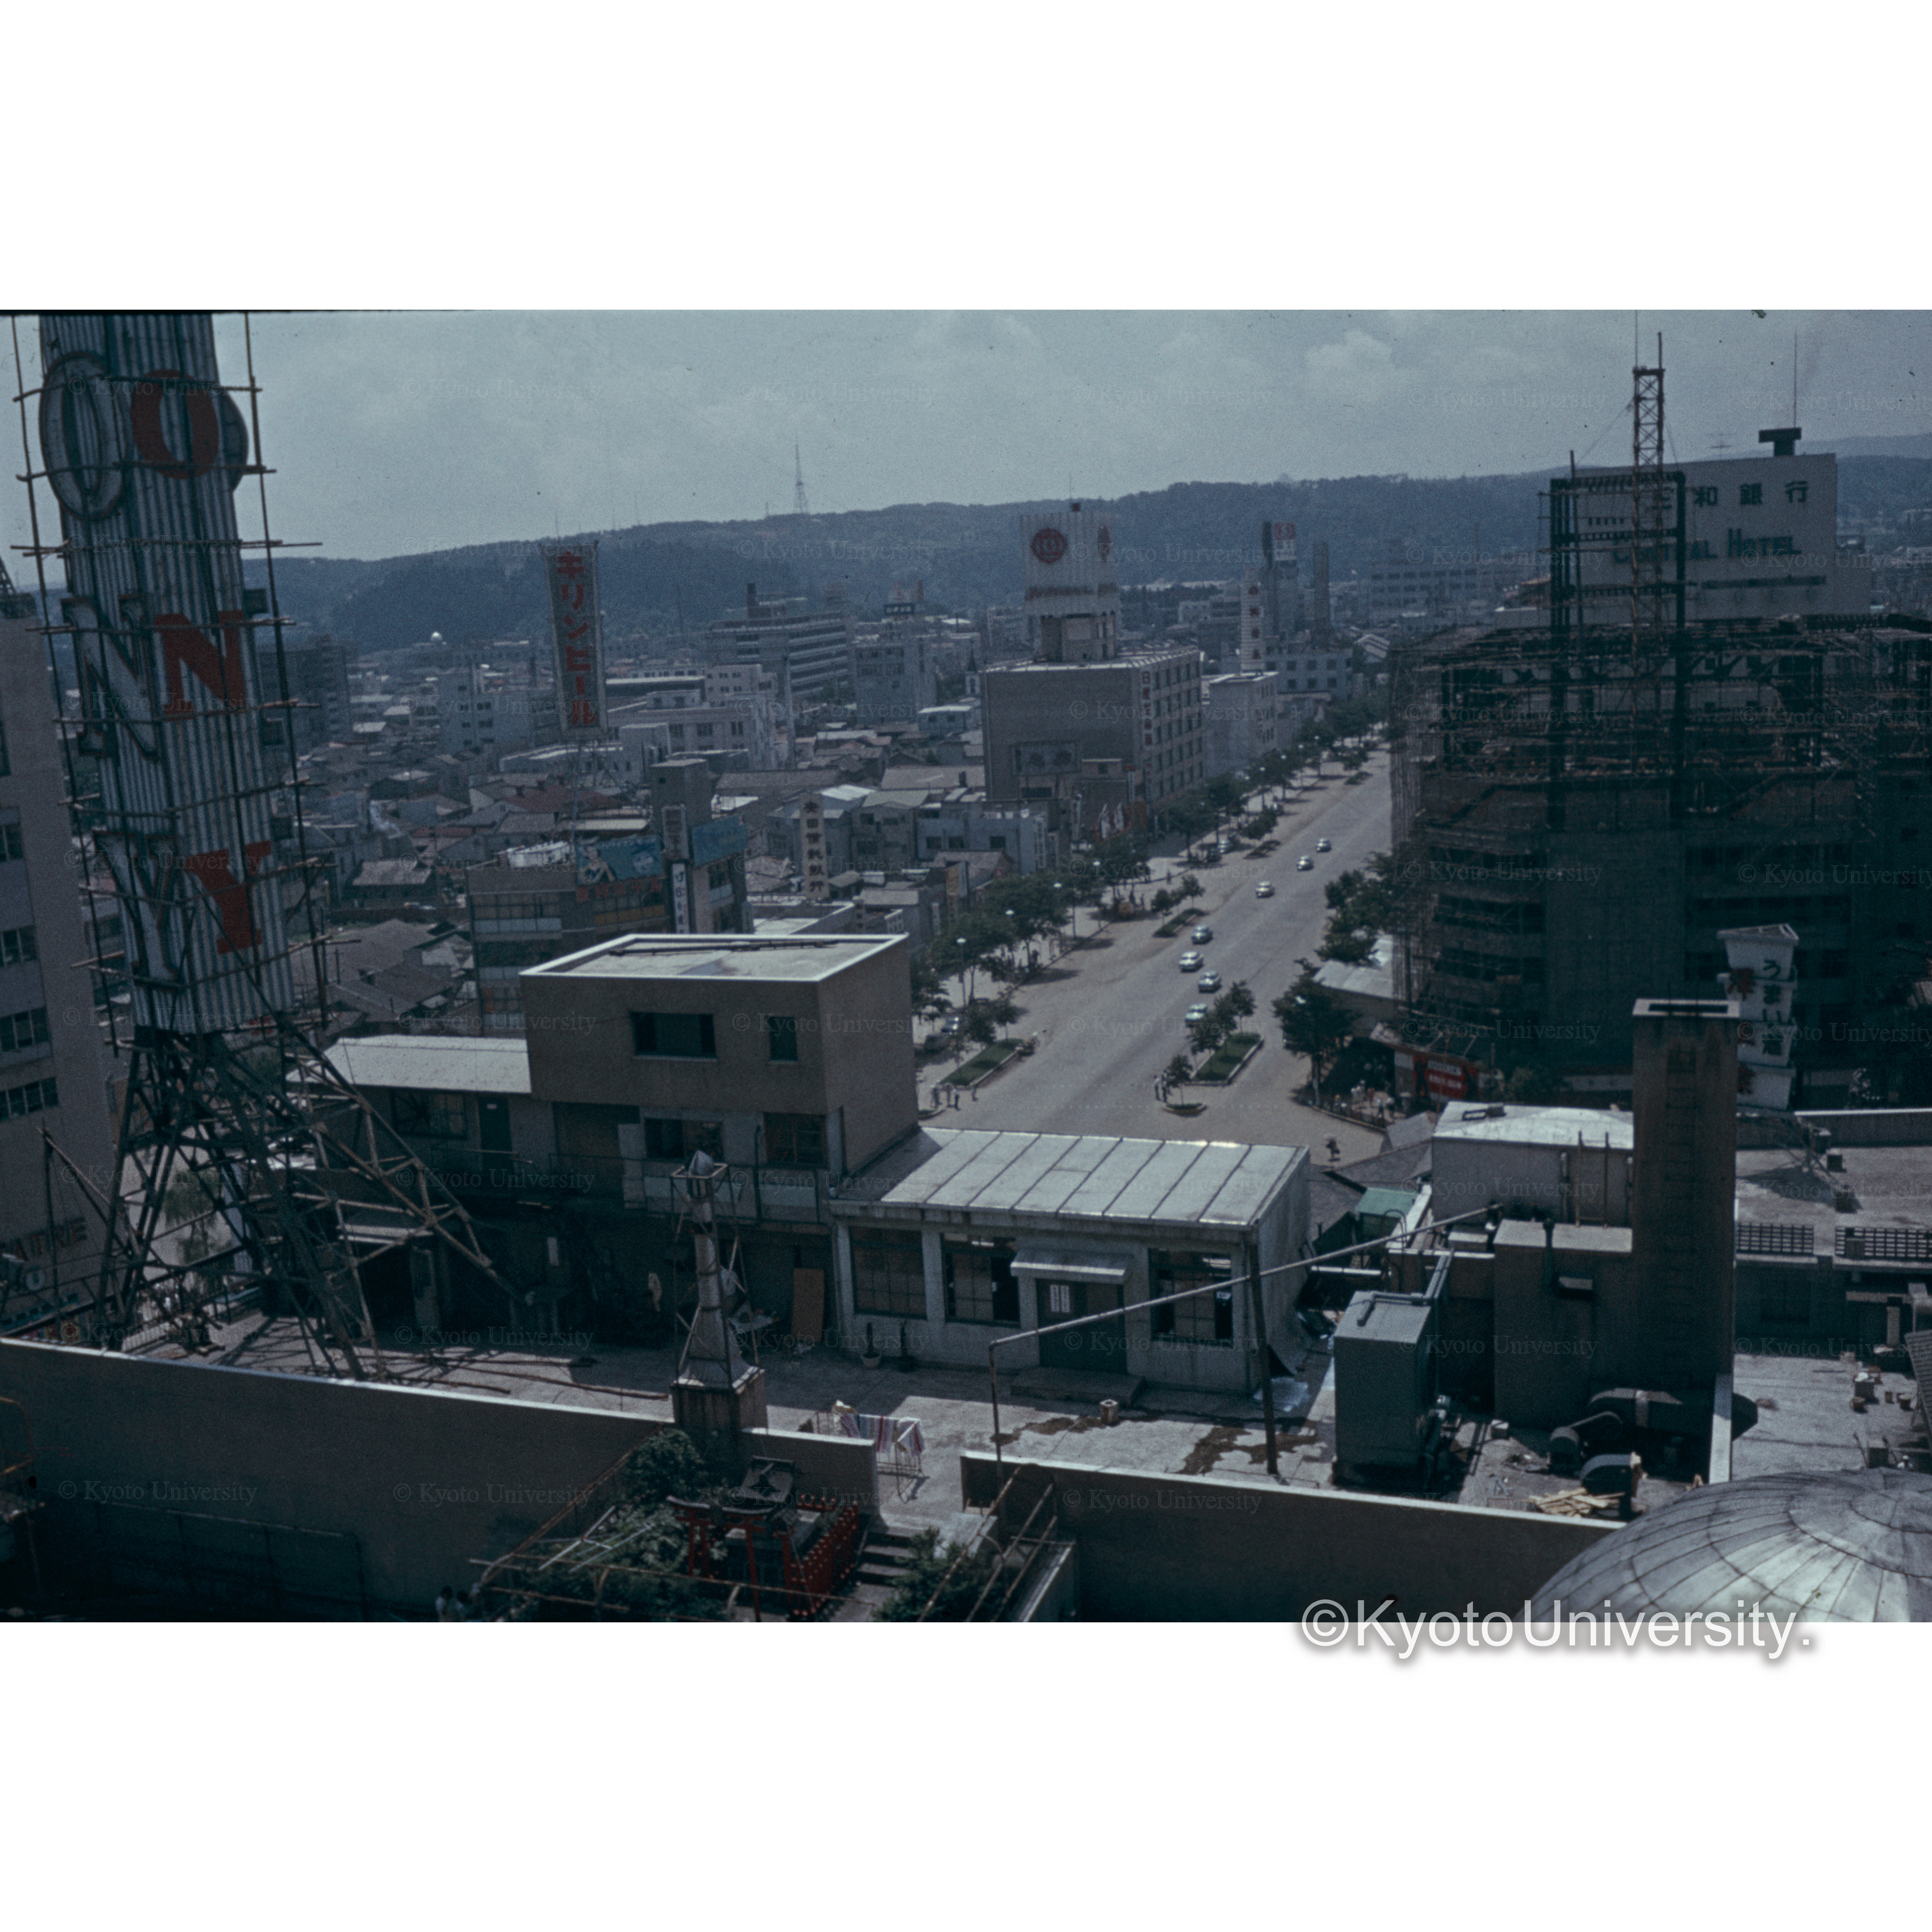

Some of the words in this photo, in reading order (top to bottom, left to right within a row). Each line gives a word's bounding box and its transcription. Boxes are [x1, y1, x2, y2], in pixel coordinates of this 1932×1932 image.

[556, 549, 598, 726] キリンビール
[0, 1216, 87, 1262] ATRE
